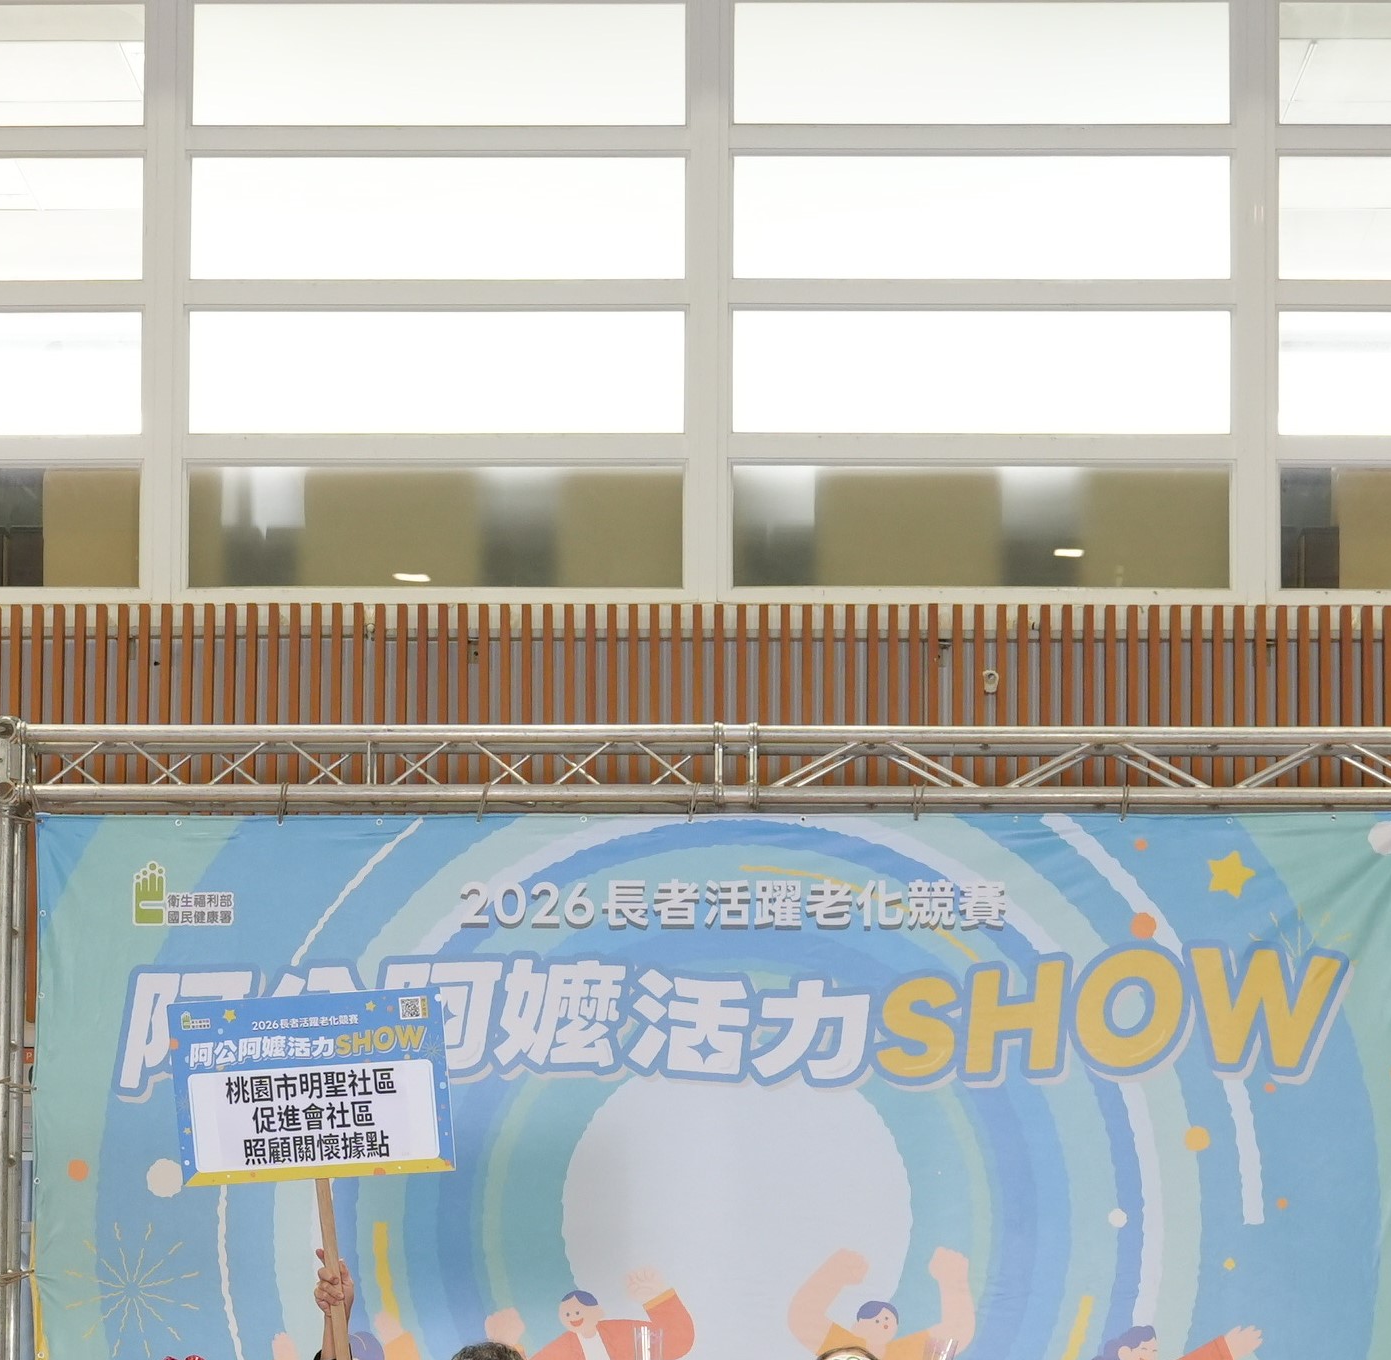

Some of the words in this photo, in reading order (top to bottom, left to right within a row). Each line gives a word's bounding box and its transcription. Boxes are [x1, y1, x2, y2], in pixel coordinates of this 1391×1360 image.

[166, 893, 233, 909] 衛生福利部
[166, 910, 233, 925] 國民健康署
[460, 878, 1007, 930] 2026長者活躍老化競賽
[189, 1025, 427, 1069] 阿公阿嬤活力SHOW
[225, 1067, 397, 1105] 桃園市明聖社區
[252, 1100, 376, 1134] 促進會社區
[243, 1130, 390, 1165] 照顧關懷據點
